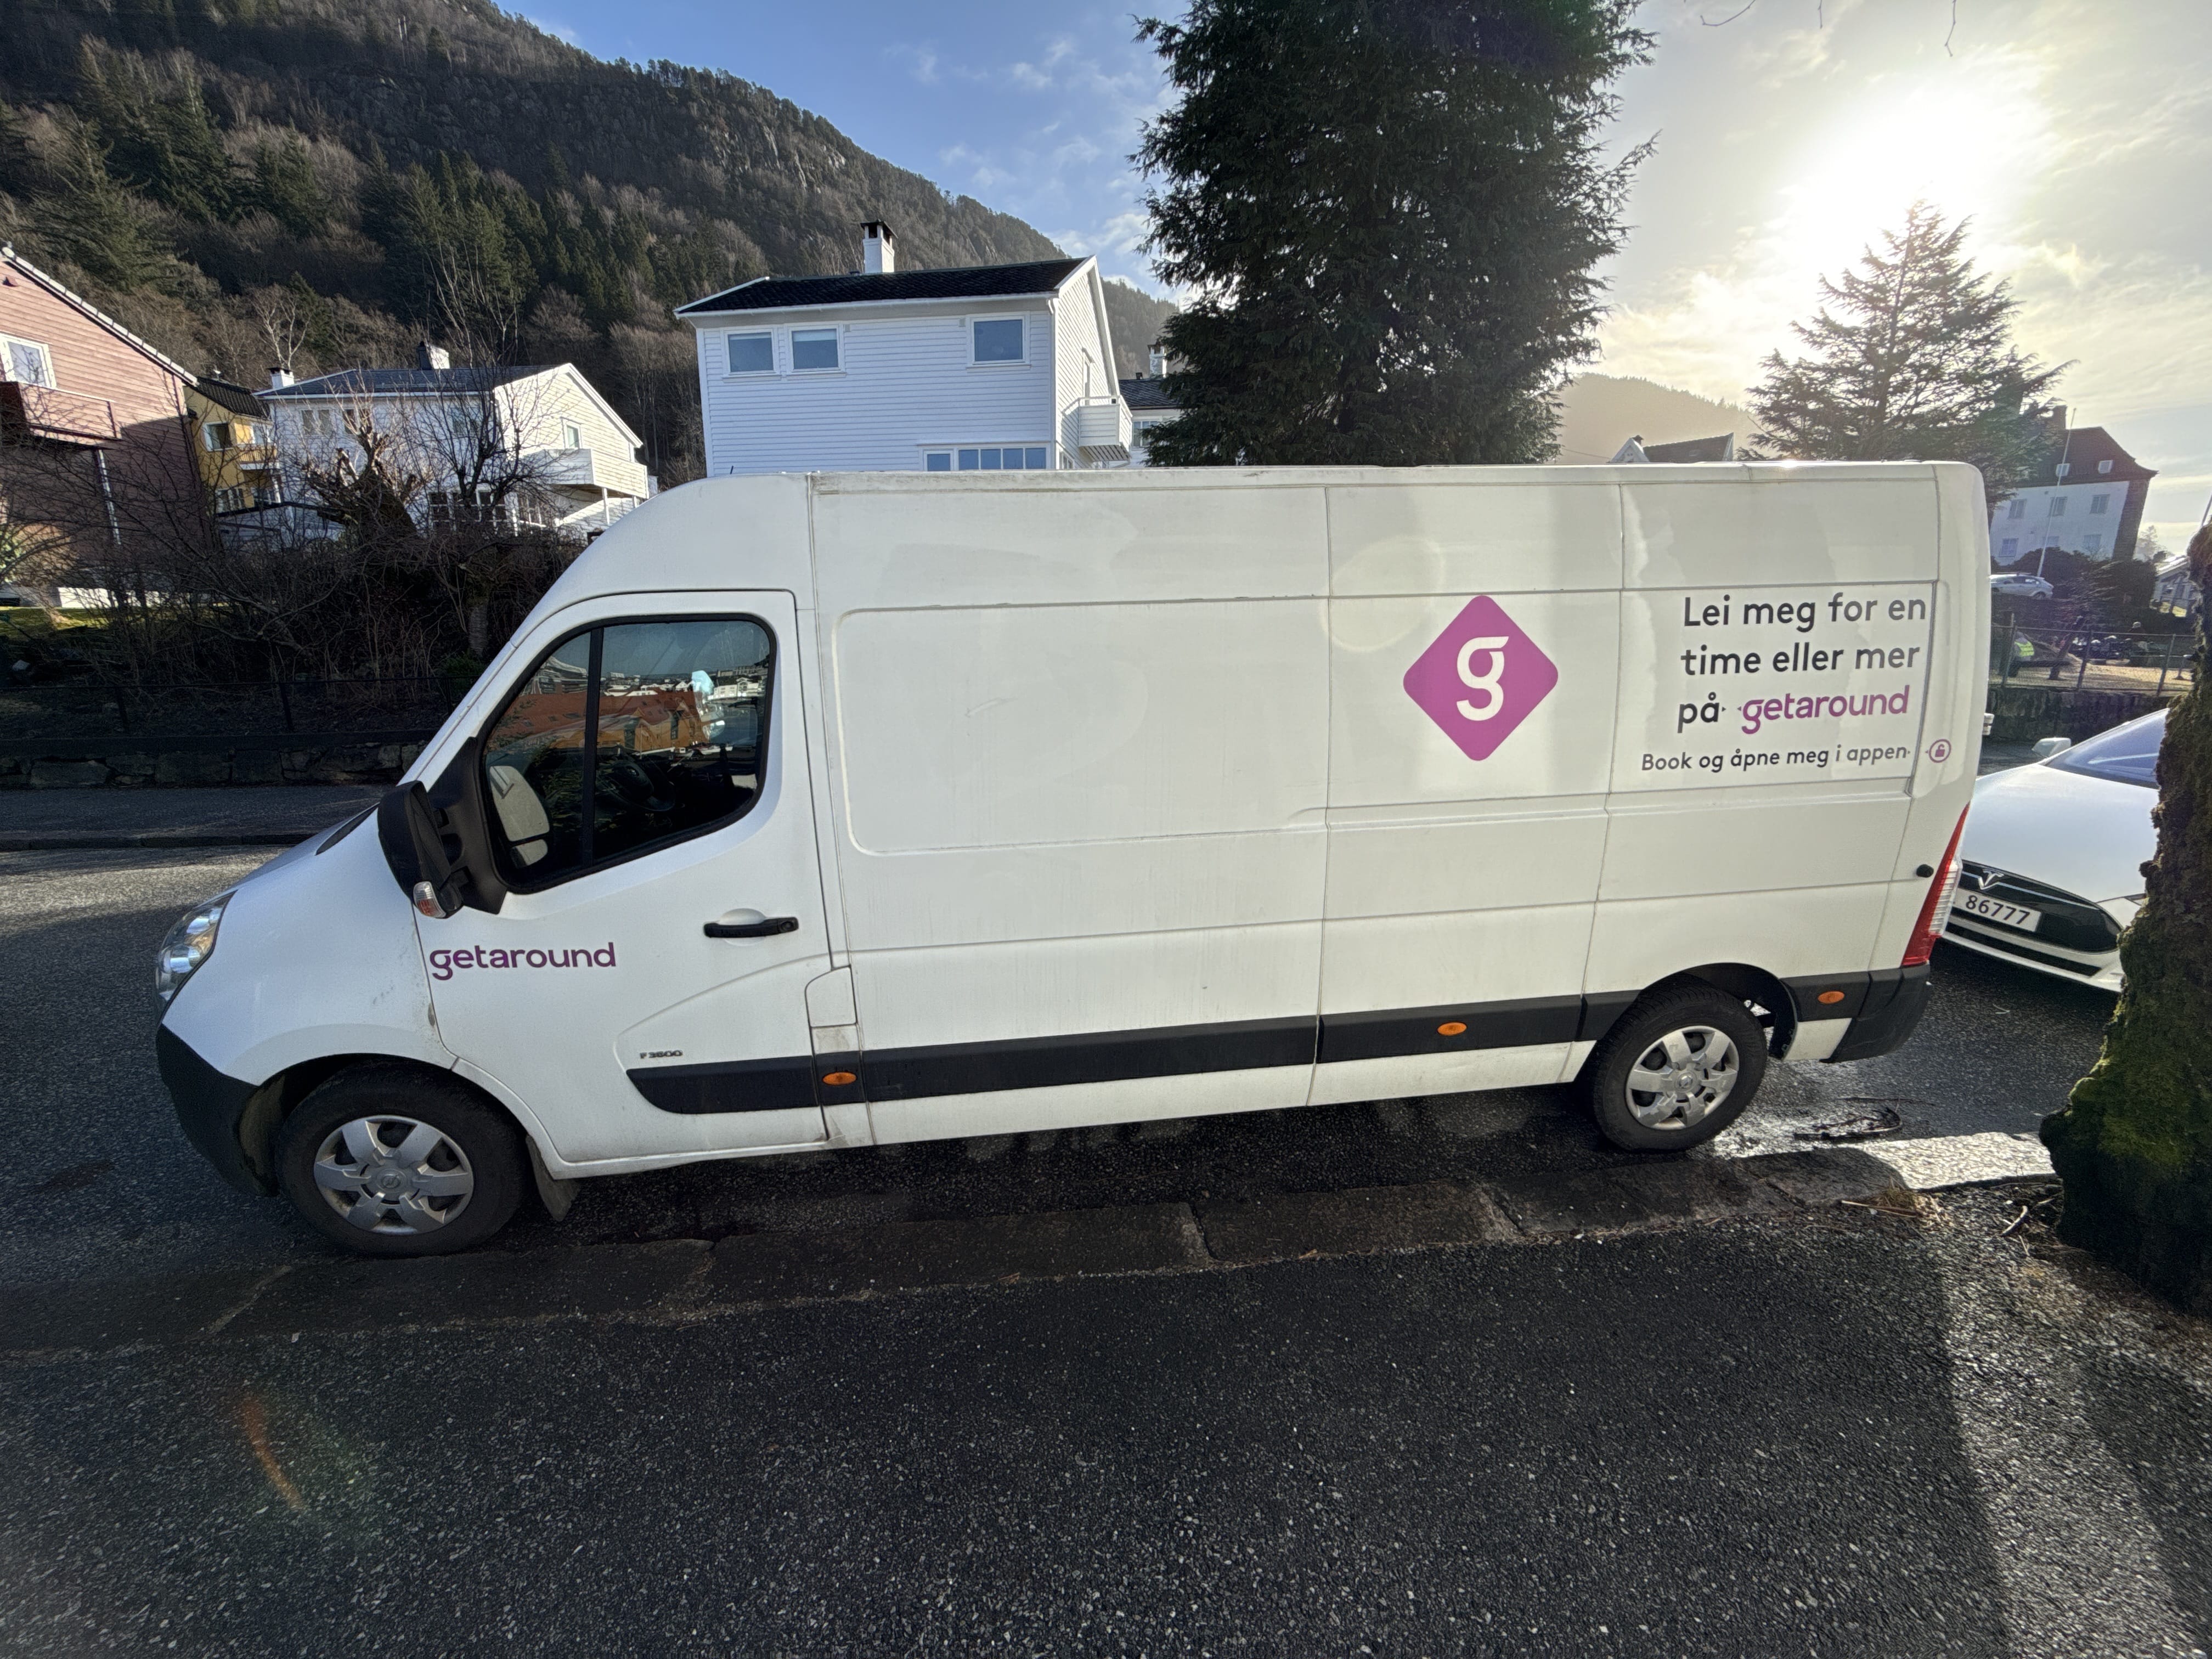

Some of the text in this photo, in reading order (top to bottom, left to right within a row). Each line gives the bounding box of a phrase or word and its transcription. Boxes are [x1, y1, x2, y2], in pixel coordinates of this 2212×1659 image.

[1684, 592, 1927, 633] Lei meg for en
[1680, 642, 1921, 675] time eller mer
[1677, 685, 1910, 735] på getaround
[1641, 744, 1906, 773] Book og åpne meg i appen
[1966, 895, 2030, 924] 86777
[429, 942, 617, 981] getaround
